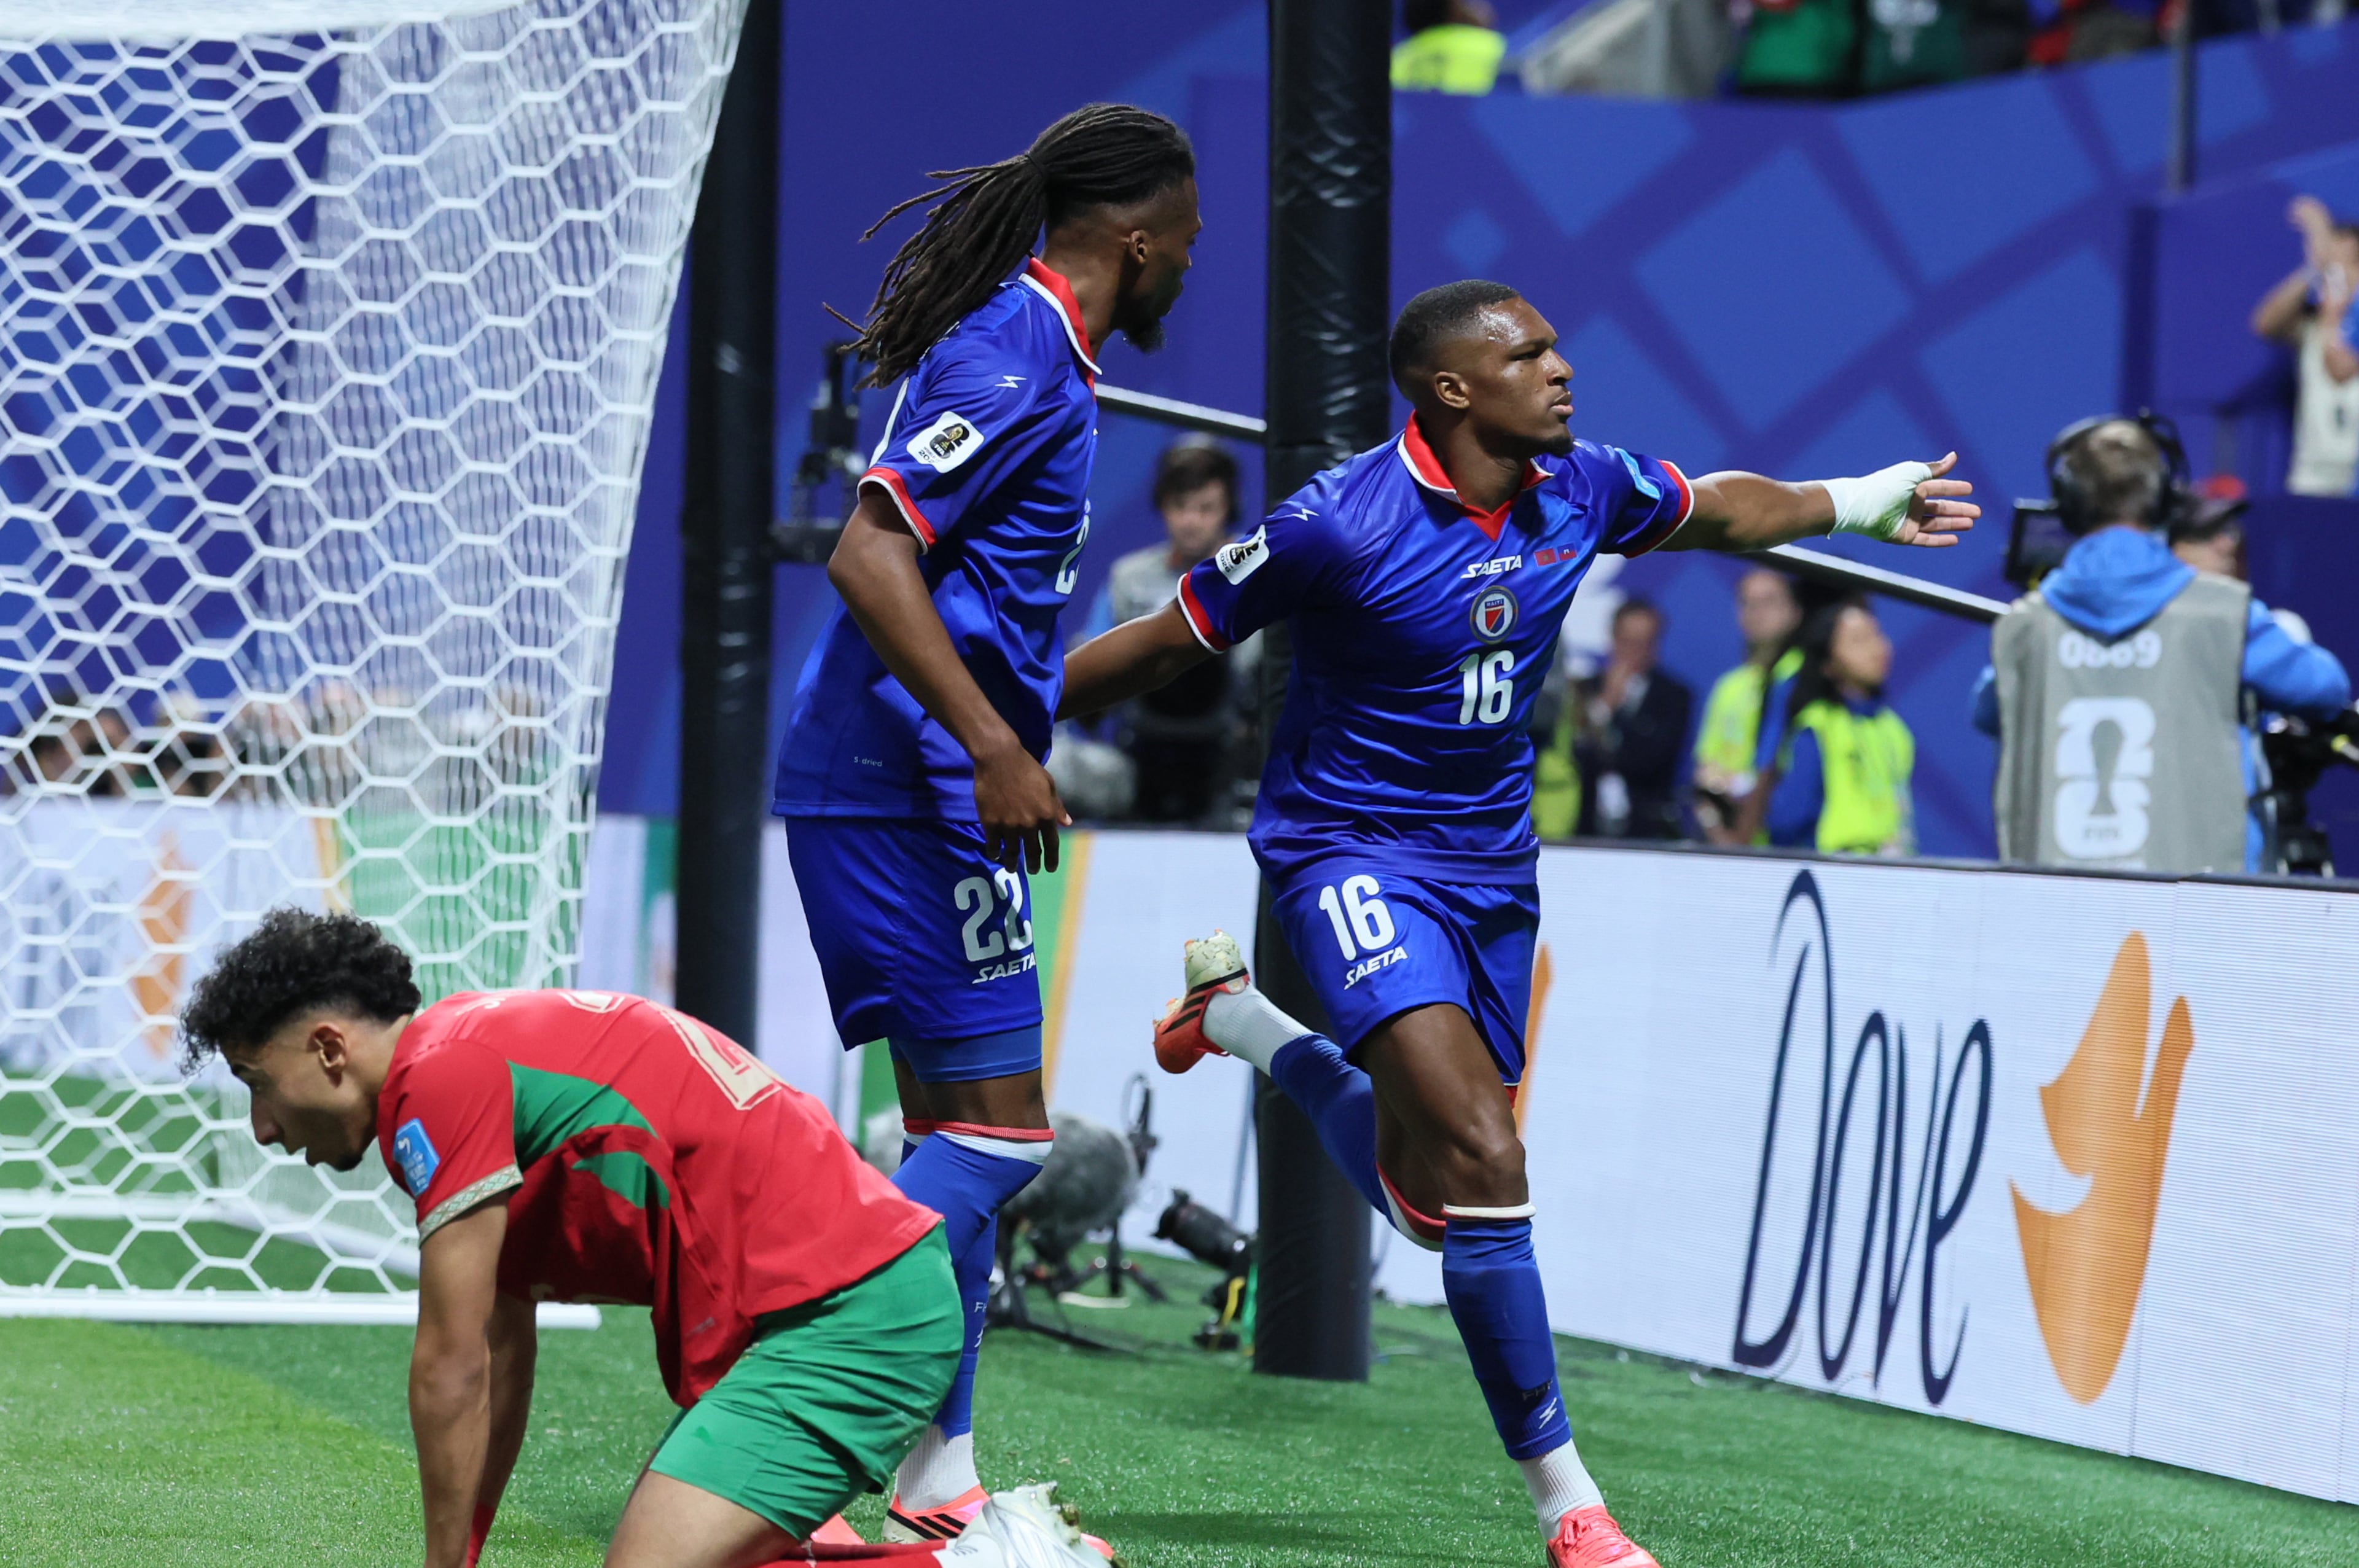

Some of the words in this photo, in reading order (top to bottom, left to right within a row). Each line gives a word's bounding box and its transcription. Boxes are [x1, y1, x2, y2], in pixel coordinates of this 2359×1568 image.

[1460, 555, 1522, 579] SAETA
[1459, 650, 1514, 725] 16
[953, 867, 1032, 962] 22
[1318, 875, 1395, 961] 16
[972, 954, 1036, 985] SAETA
[1344, 946, 1407, 990] SAETA
[1732, 868, 1992, 1406] Dove
